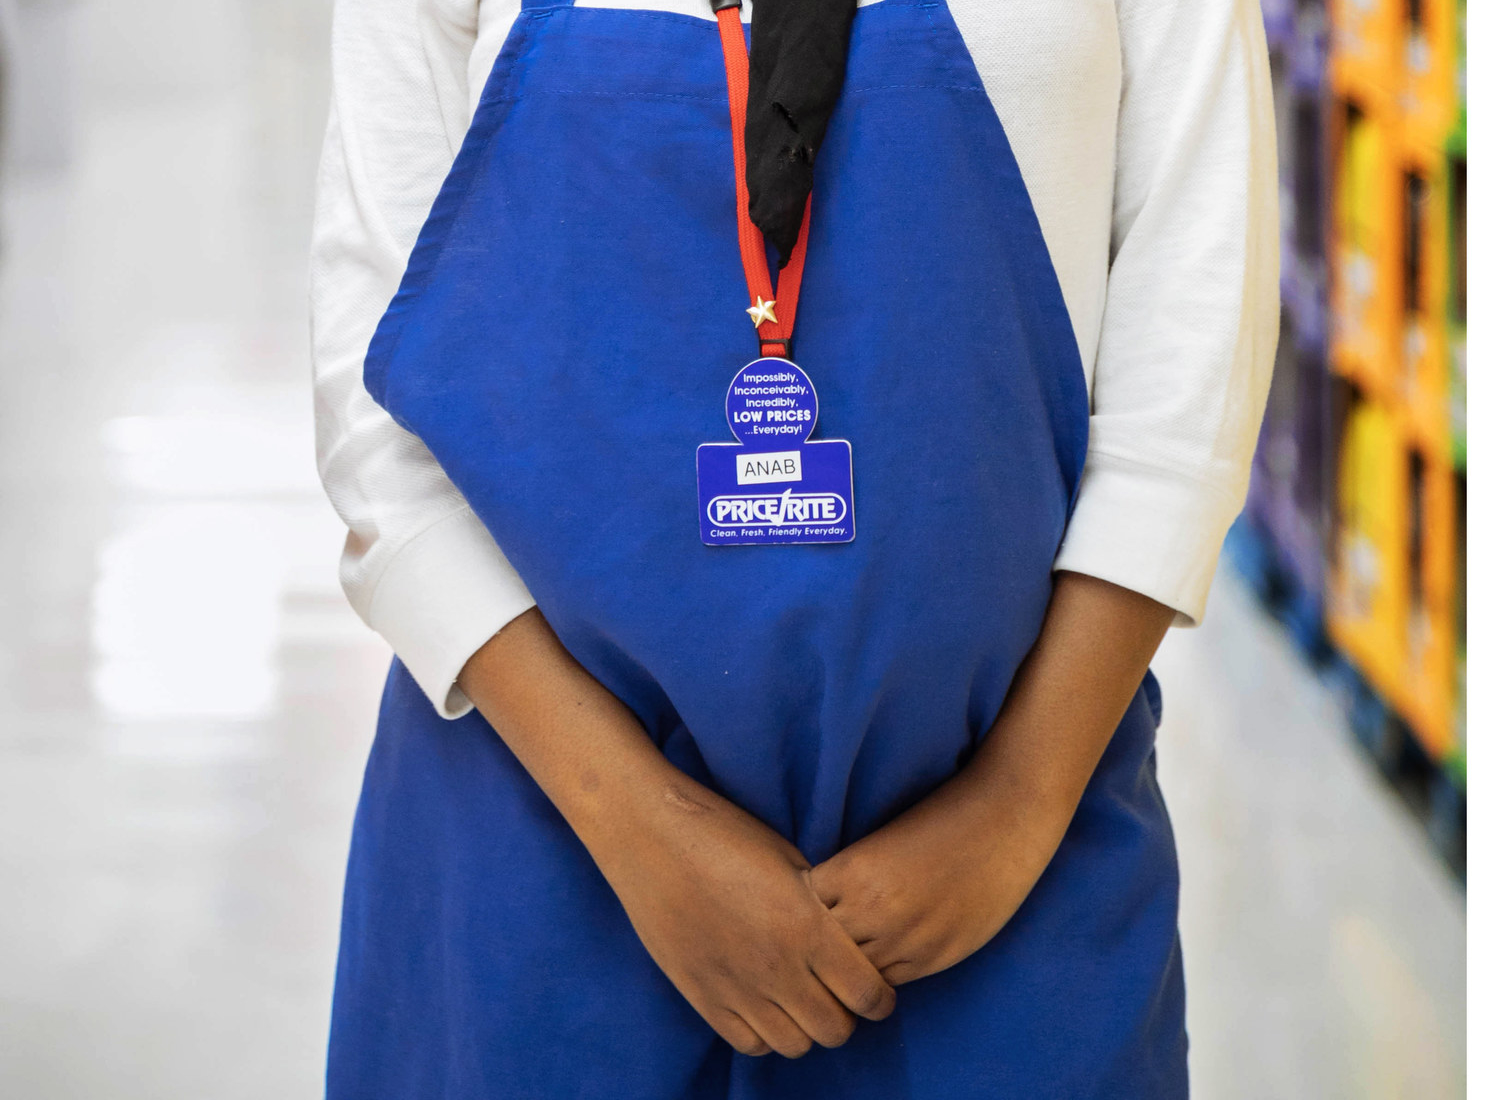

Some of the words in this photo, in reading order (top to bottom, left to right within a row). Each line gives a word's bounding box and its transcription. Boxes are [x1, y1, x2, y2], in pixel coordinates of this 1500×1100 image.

[734, 411, 762, 423] LOW
[767, 410, 811, 422] PRICES
[745, 459, 796, 477] ANAB
[769, 528, 802, 537] Friendly
